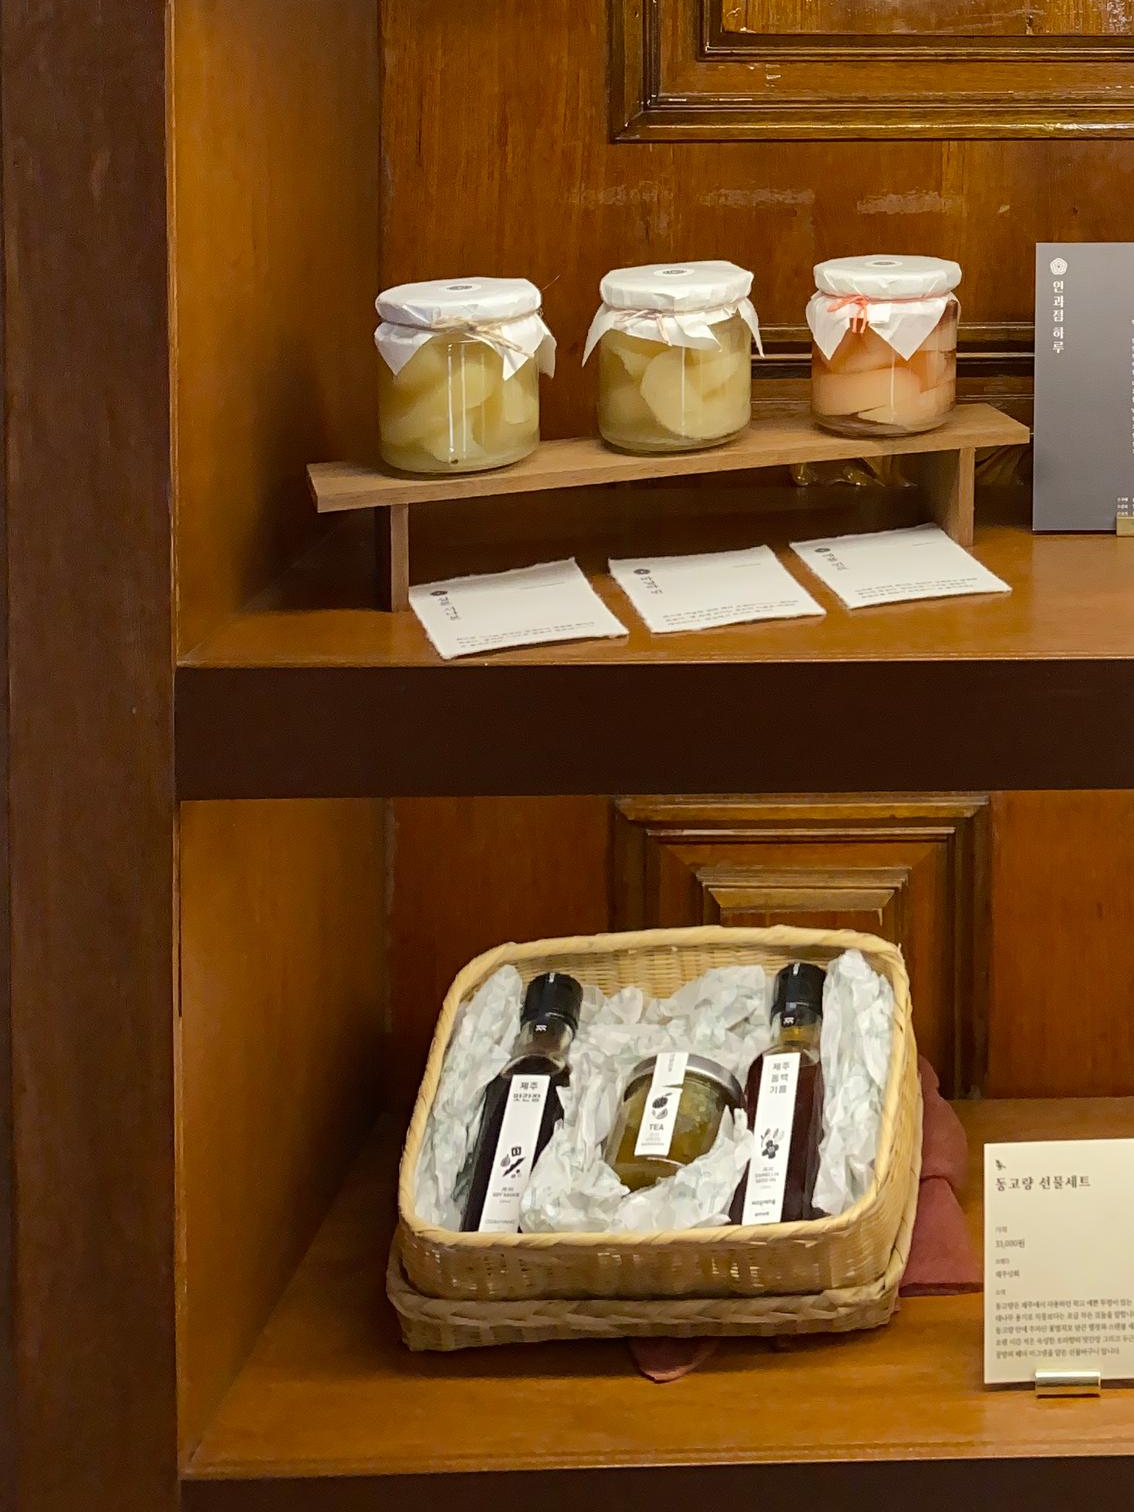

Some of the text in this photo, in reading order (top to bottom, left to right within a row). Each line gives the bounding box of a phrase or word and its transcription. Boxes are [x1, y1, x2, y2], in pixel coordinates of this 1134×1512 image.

[1053, 327, 1064, 354] 하루
[995, 1175, 1091, 1191] 동고량 선물세트
